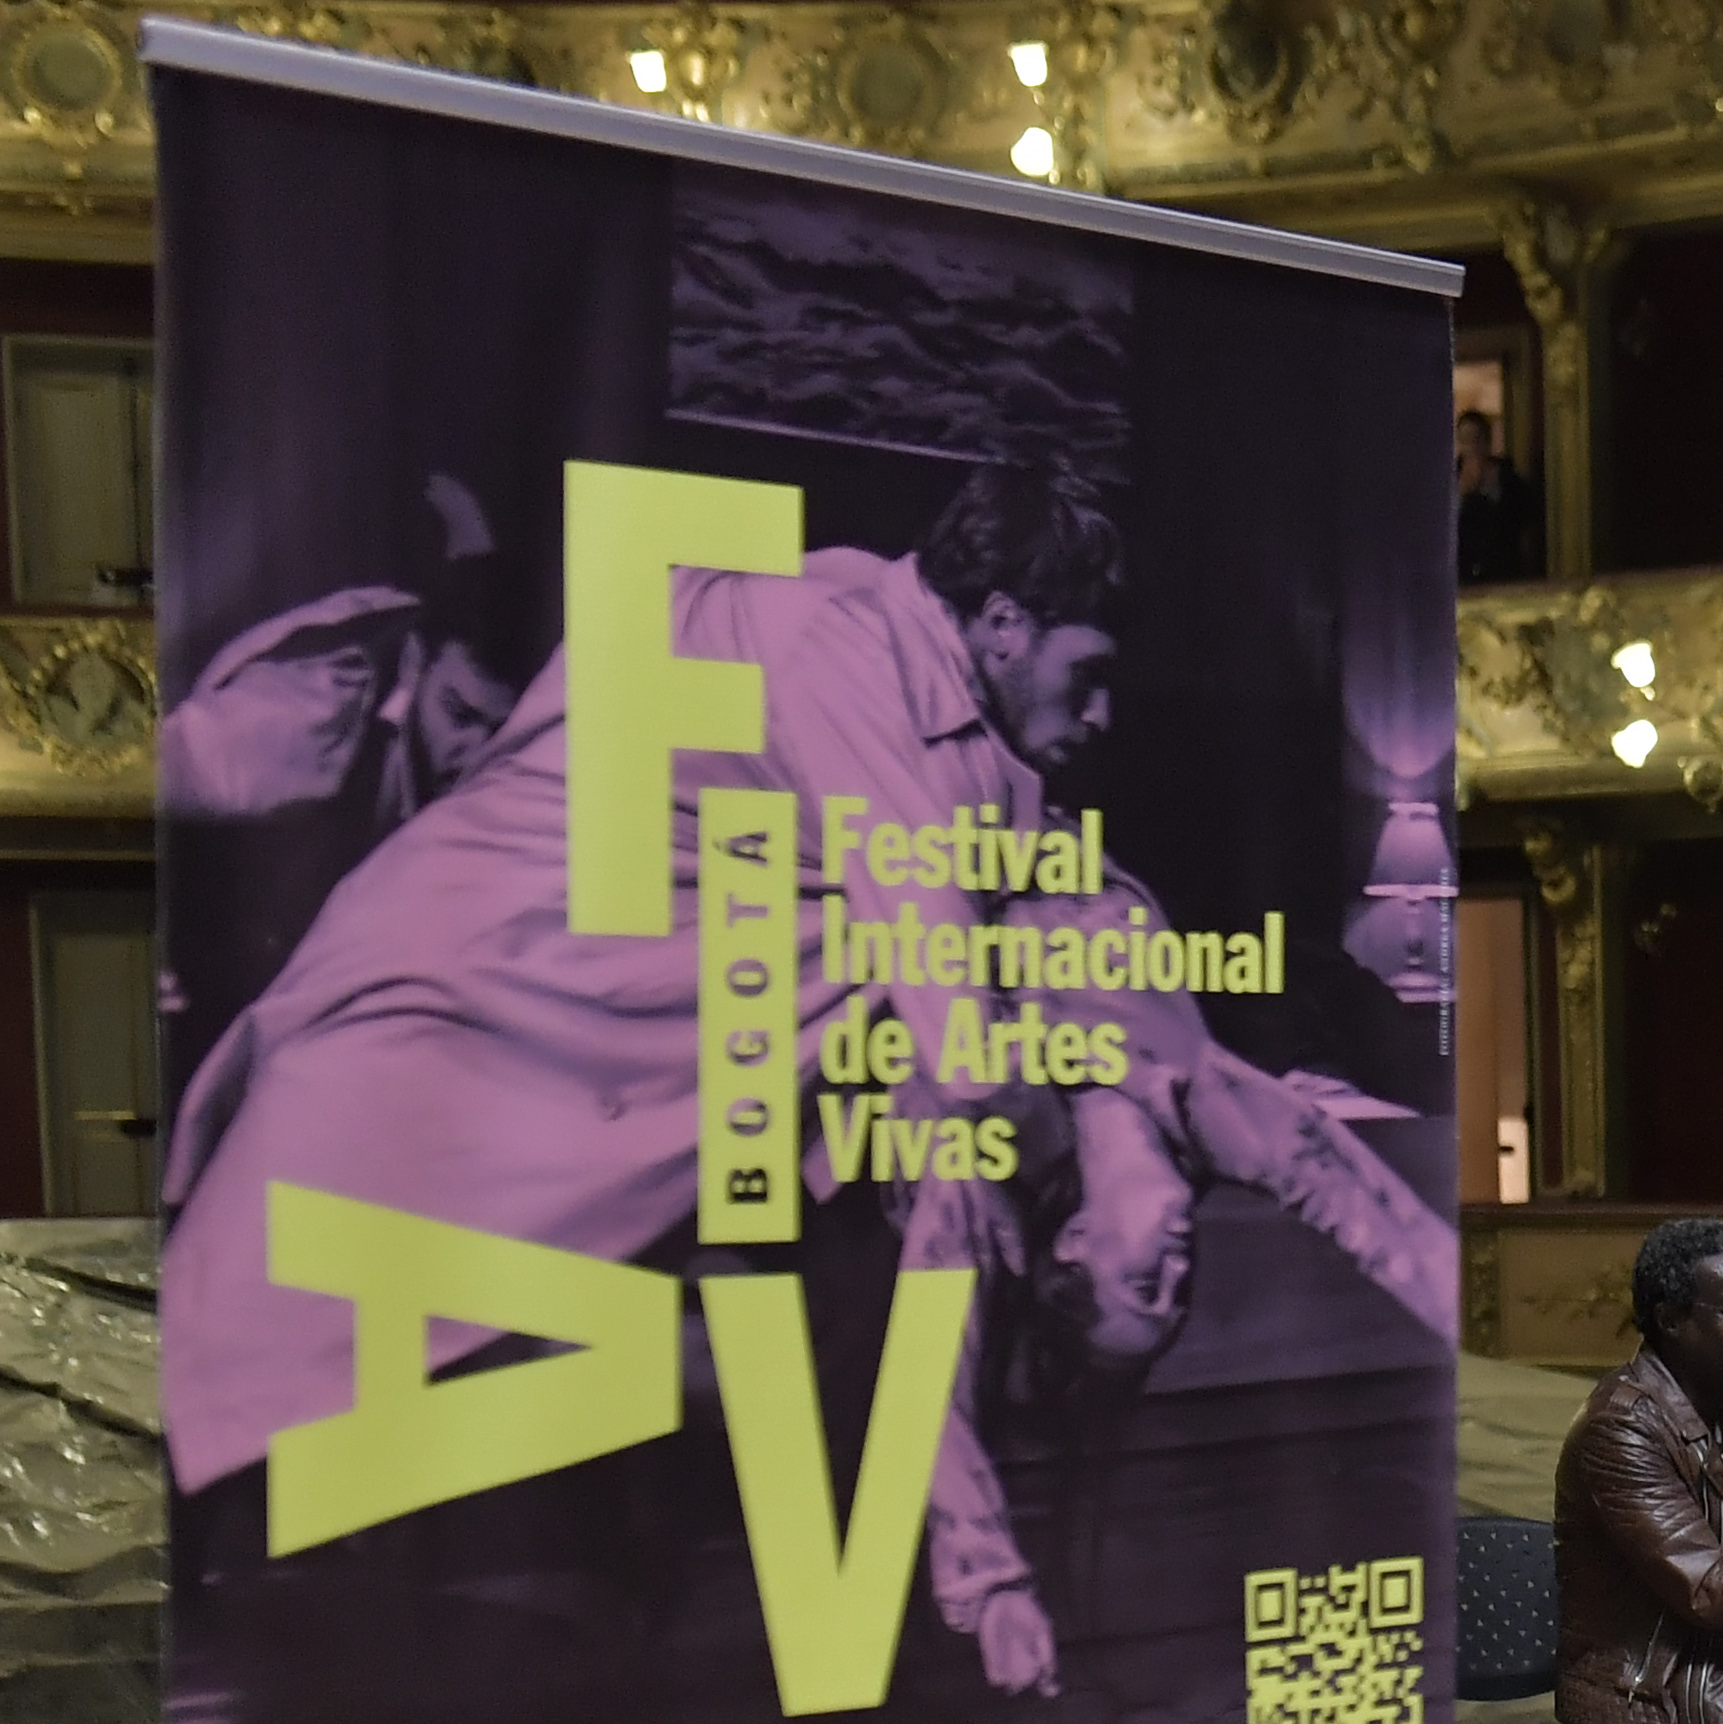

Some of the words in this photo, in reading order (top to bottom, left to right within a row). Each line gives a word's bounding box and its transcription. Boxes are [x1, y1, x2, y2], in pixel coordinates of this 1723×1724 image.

[821, 795, 1104, 894] Festival
[821, 895, 1286, 993] Internacional
[711, 830, 770, 1205] BOGOTÁ
[820, 995, 915, 1085] de
[936, 998, 1131, 1086] Artes
[817, 1094, 1020, 1182] Vivas
